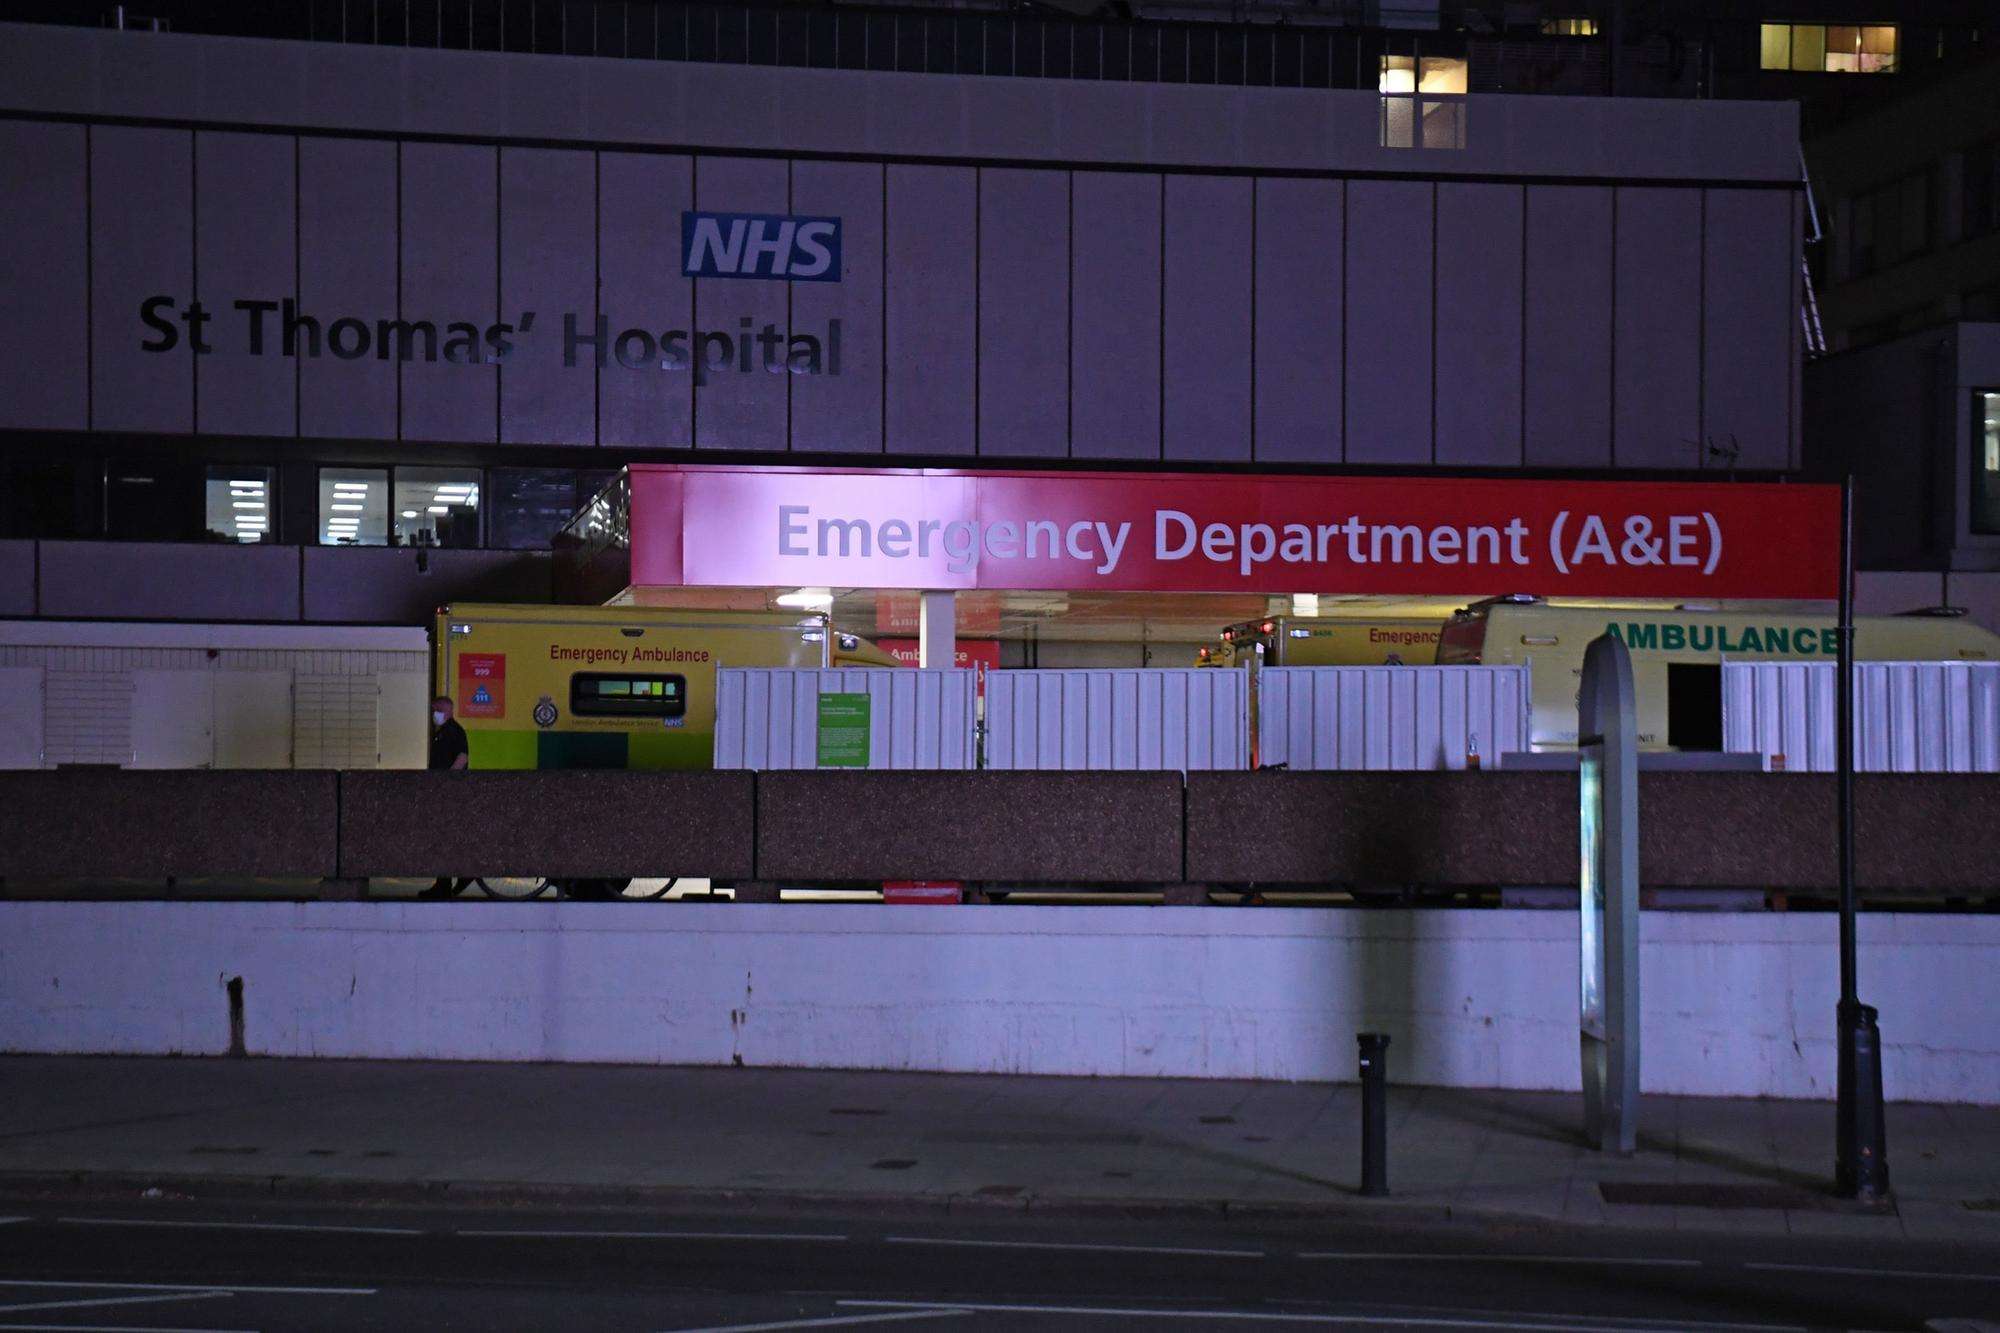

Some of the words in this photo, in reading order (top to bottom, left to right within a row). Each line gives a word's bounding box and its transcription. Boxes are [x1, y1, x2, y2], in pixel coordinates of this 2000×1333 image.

[686, 217, 835, 277] NHS
[140, 296, 212, 355] St
[564, 313, 842, 386] Hospital
[778, 505, 1132, 576] Emergency
[1155, 509, 1531, 577] Department
[1550, 511, 1722, 575] (A&E)
[550, 645, 628, 664] Emergency
[632, 646, 710, 663] Ambulance
[1370, 628, 1440, 645] Emergenc
